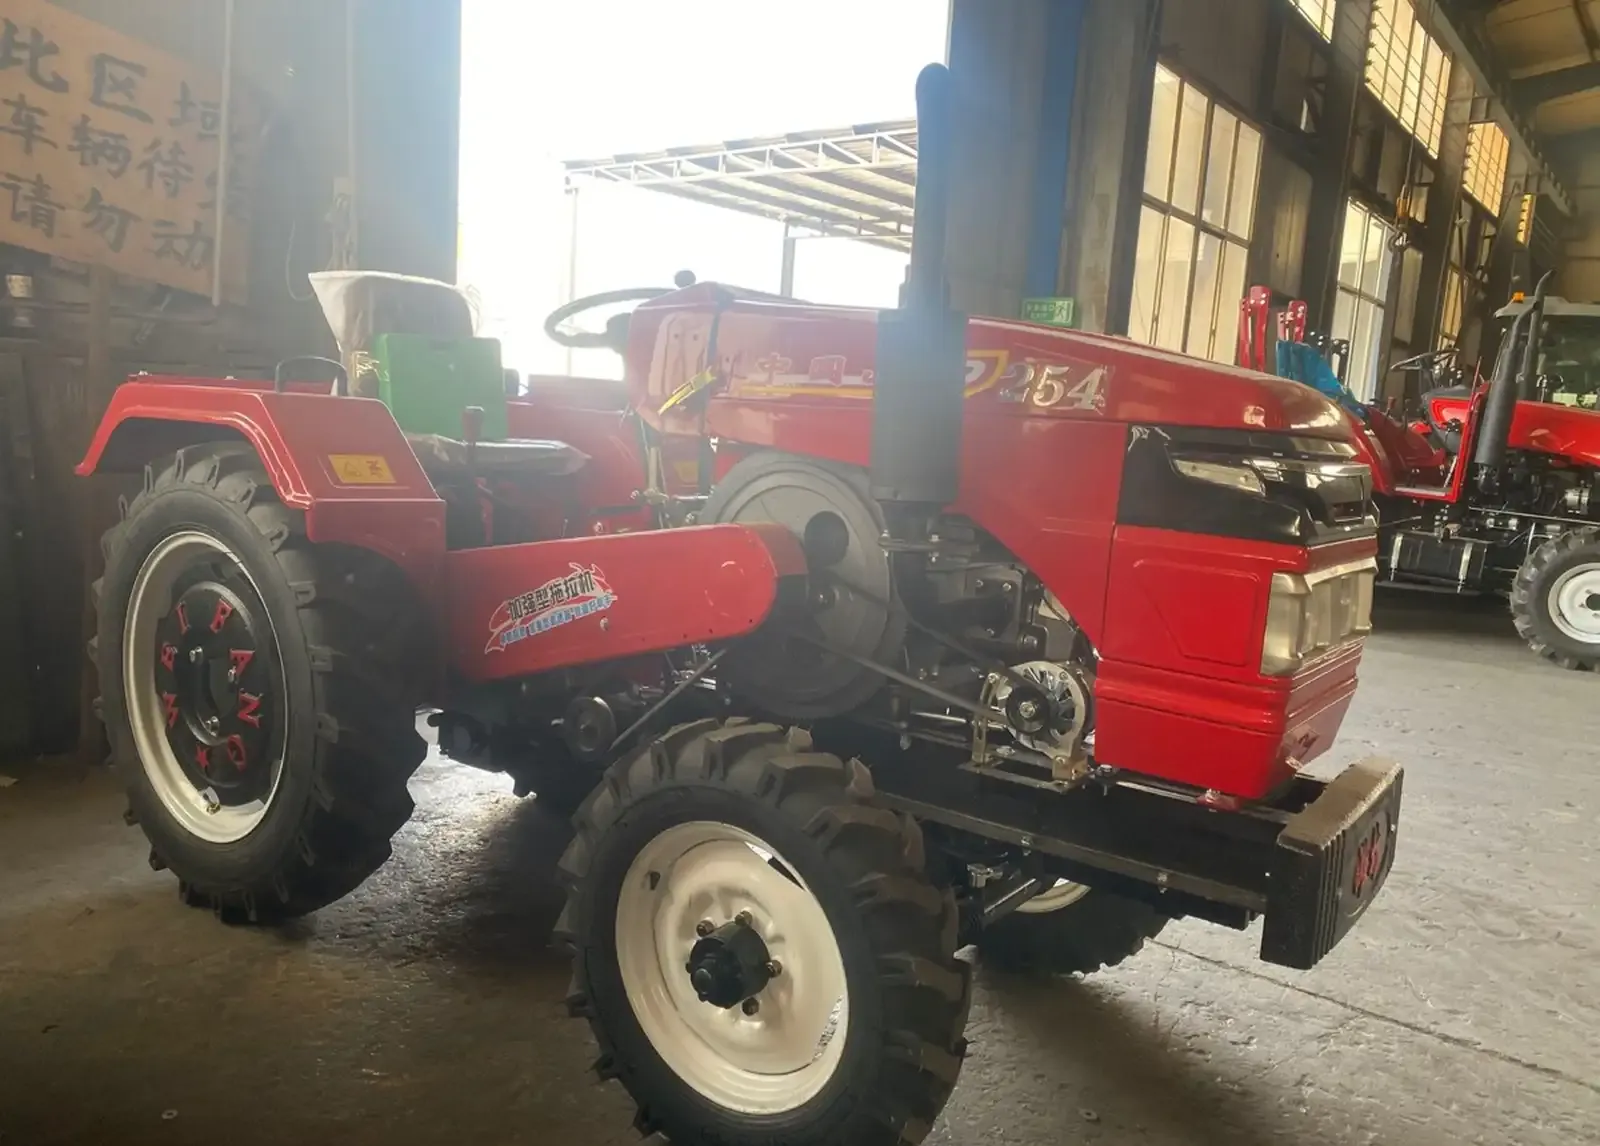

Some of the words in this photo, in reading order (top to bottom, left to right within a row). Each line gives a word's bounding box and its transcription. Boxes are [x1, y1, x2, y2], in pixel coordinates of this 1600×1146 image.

[1000, 363, 1107, 410] 254
[507, 571, 595, 622] 加强型拖拉机
